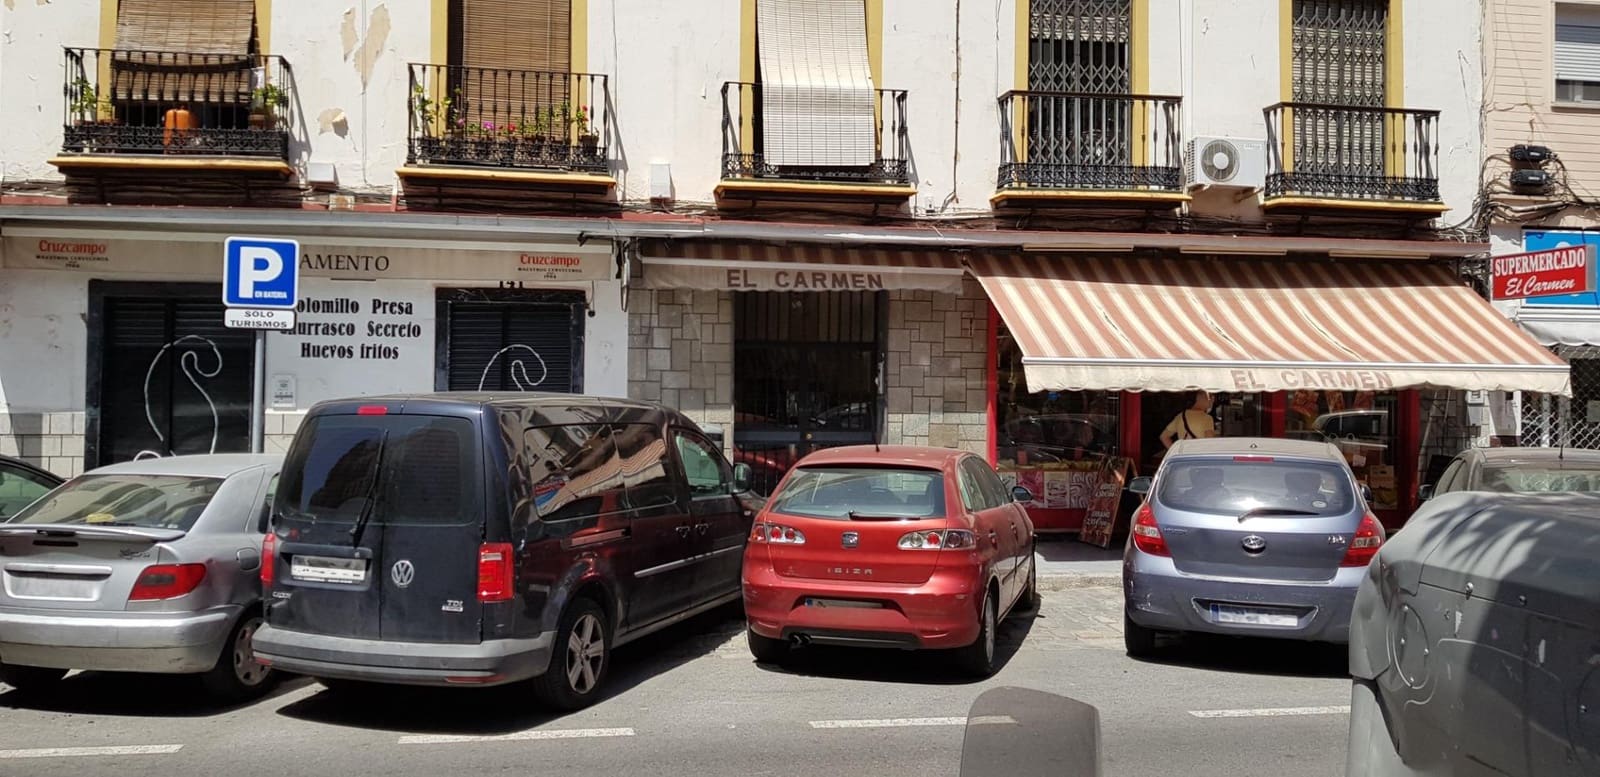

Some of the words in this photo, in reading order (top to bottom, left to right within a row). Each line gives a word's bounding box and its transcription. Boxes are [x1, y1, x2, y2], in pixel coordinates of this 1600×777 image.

[39, 240, 106, 255] Cruzcampo
[299, 254, 389, 271] AMENTO
[520, 254, 580, 267] Cruzcampo
[1495, 248, 1585, 277] SUPERMERCADO
[239, 246, 283, 298] P
[727, 269, 757, 288] EL
[774, 271, 883, 289] CARMEN
[1505, 278, 1522, 296] El
[1523, 275, 1576, 295] Carmen
[296, 298, 359, 313] olomillo
[372, 299, 413, 315] Presa
[230, 320, 287, 328] TURISMOS
[281, 322, 355, 336] urrasco
[367, 321, 421, 337] Secreto
[301, 343, 354, 359] Huevos
[360, 343, 399, 359] fritos
[1231, 370, 1265, 389] EL
[1281, 371, 1393, 389] CARMEN
